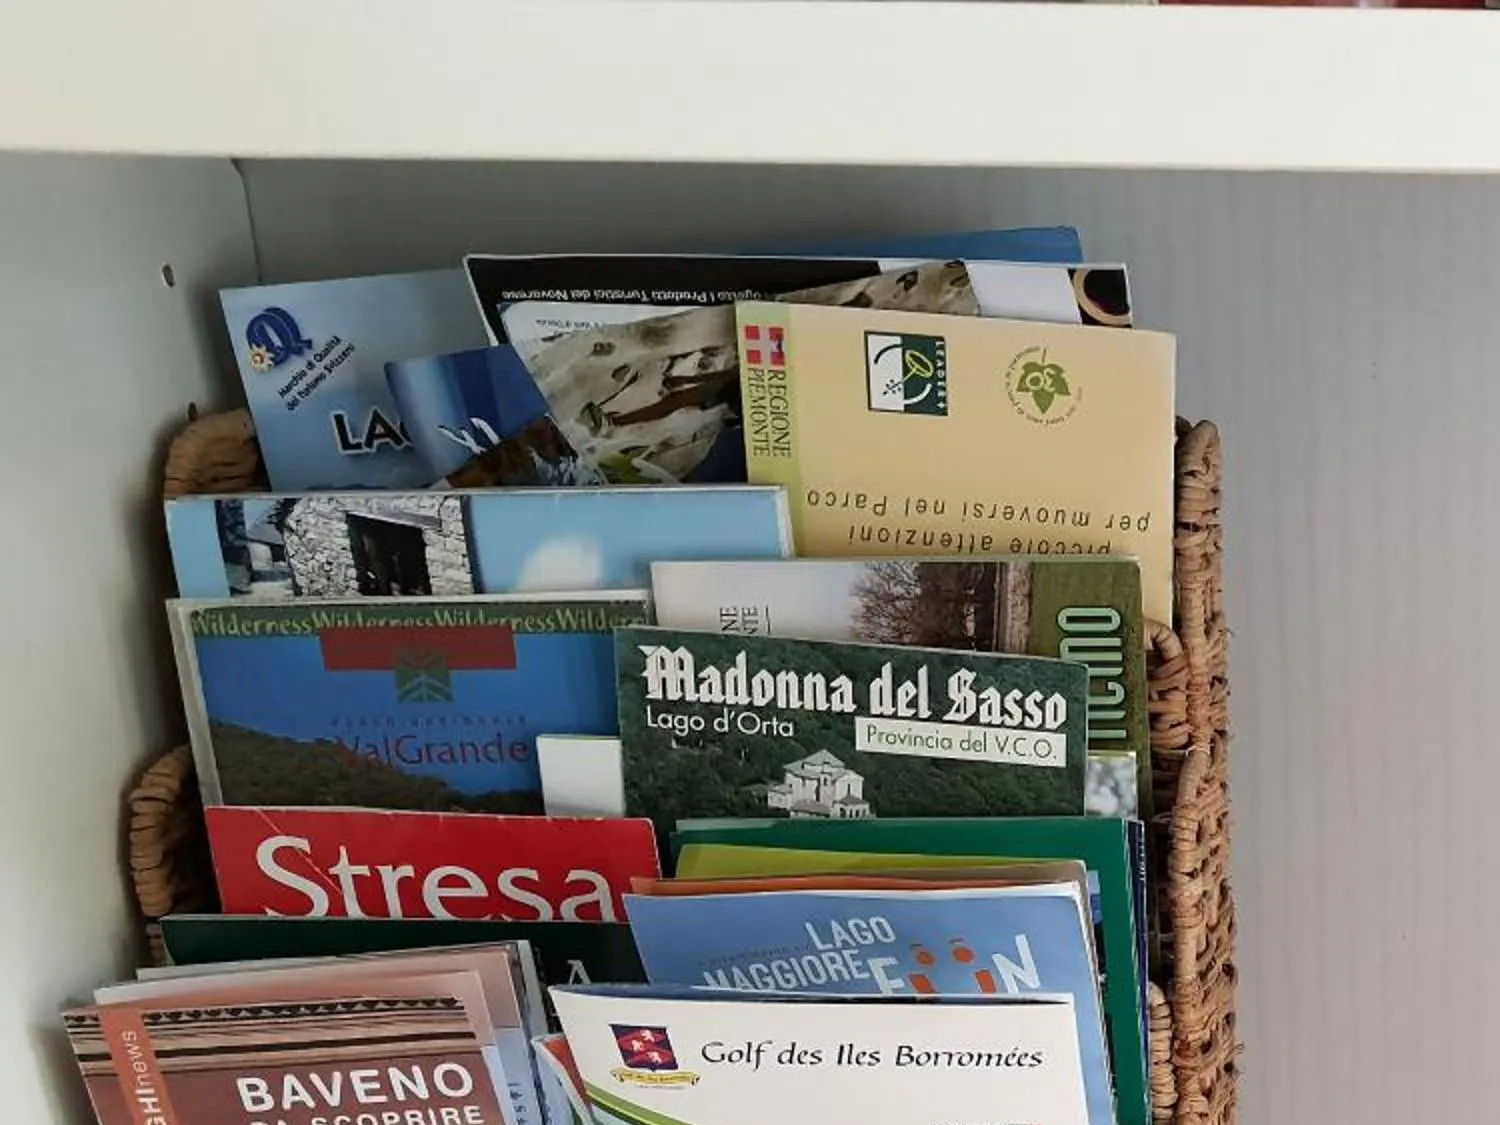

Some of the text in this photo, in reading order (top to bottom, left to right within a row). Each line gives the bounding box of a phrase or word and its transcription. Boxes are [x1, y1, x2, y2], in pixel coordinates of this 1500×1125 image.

[747, 366, 770, 457] PIEMONTE
[767, 369, 792, 458] REGIONE
[807, 489, 1152, 533] per muoversi nel Parco
[848, 525, 994, 553] attenzioni
[638, 644, 1067, 730] Madonna del Sasso
[646, 708, 794, 738] Lago d'Orta
[866, 723, 1058, 761] Provincia del V.C.O.
[255, 834, 630, 921] Stresa
[804, 914, 898, 951] LAGO
[702, 949, 871, 991] MAGGIORE
[700, 1038, 1044, 1069] Golf des Iles Borromées
[236, 1061, 475, 1113] BAVENO
